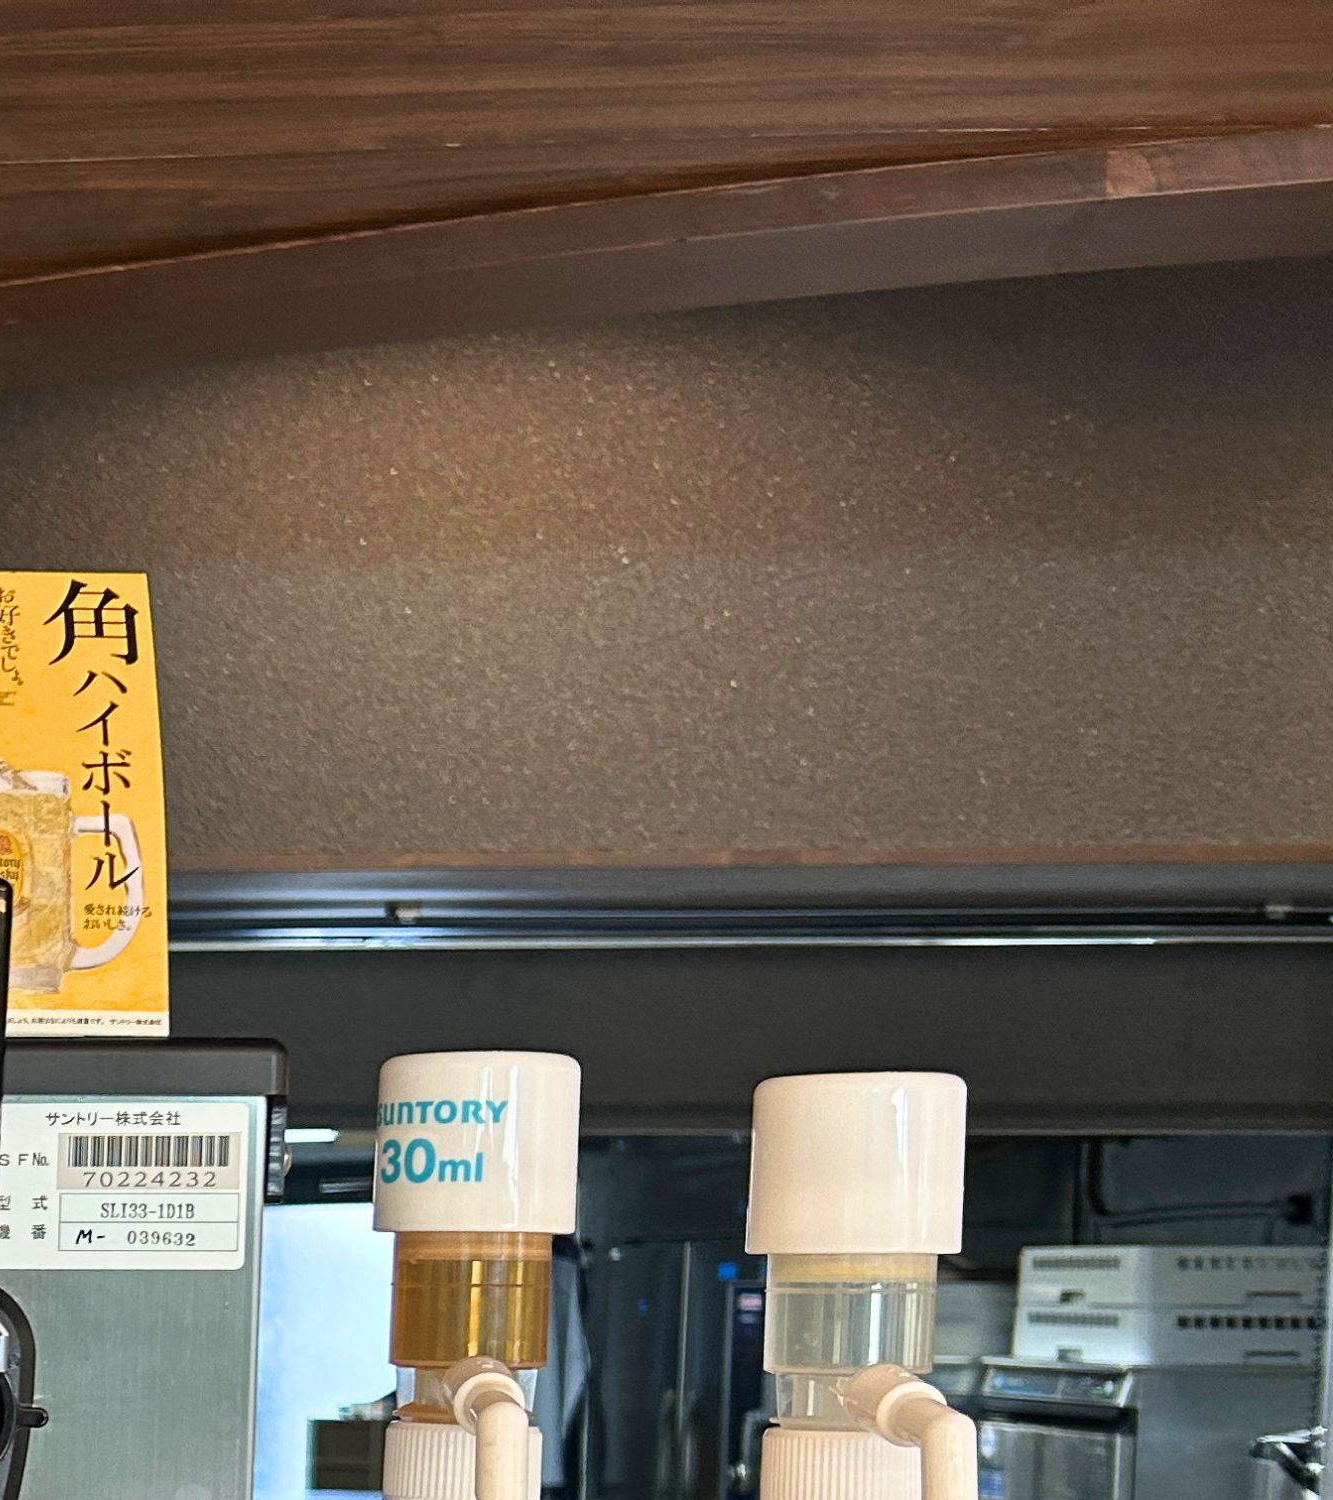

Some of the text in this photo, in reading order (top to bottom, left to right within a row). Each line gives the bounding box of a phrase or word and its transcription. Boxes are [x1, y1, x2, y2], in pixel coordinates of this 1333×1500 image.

[44, 579, 140, 891] 角ハイボール
[45, 1111, 181, 1126] サントリー株式会社
[380, 1138, 484, 1184] 30ml
[83, 1171, 217, 1188] 70224232
[127, 1230, 196, 1246] 039632
